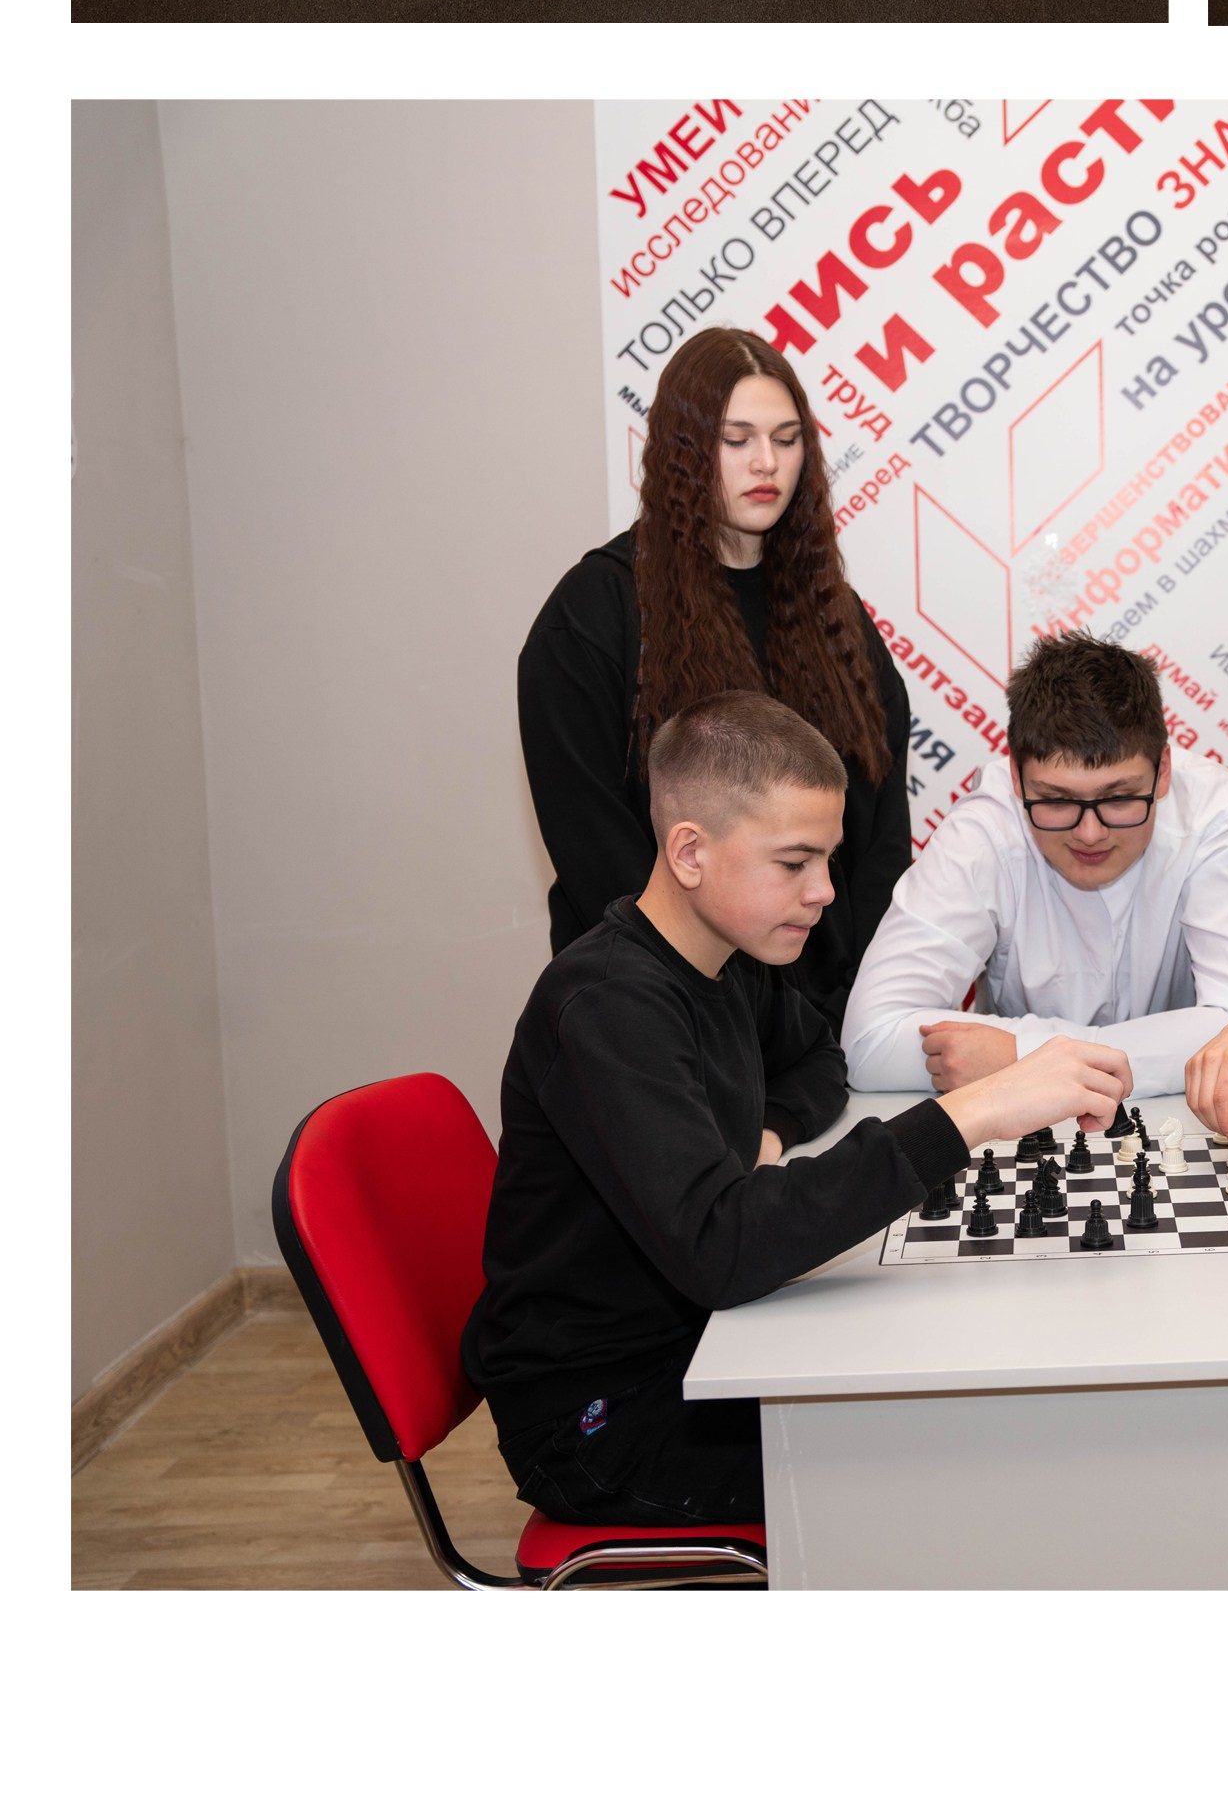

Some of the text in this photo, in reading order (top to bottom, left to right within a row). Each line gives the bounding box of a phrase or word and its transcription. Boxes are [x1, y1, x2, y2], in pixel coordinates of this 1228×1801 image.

[617, 99, 901, 371] ТОЛЬКО ВПЕРЕД
[750, 168, 962, 355] чись
[909, 210, 1162, 459] ТВОРЧЕСТВО
[1114, 259, 1197, 338] точка
[853, 312, 937, 393] и
[1120, 354, 1180, 411] на
[820, 363, 893, 443] труд
[1156, 573, 1177, 593] в
